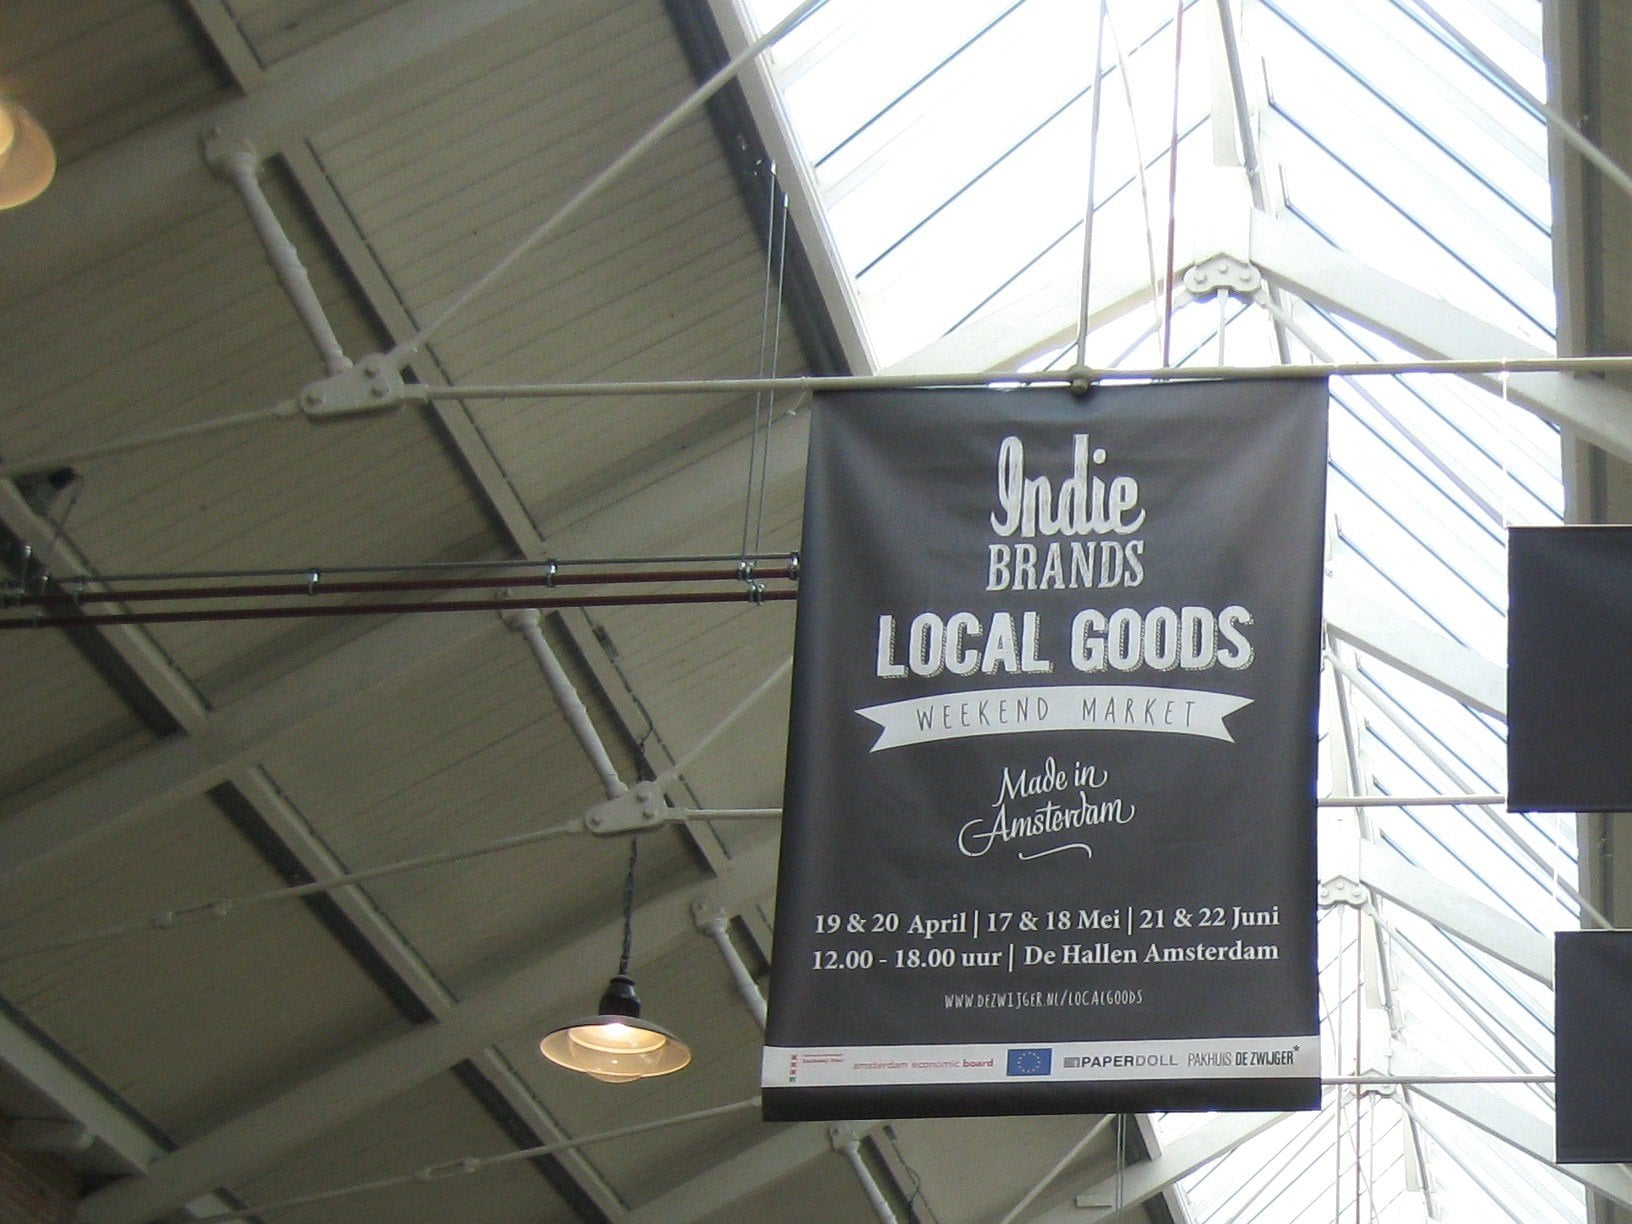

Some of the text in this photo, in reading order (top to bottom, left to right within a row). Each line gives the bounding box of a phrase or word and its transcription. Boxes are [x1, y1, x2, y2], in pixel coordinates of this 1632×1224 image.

[990, 433, 1146, 538] Indie
[985, 539, 1144, 591] BRANDS
[876, 605, 1254, 678] LOCAL GOODS
[916, 696, 1195, 732] WEEKEND MARKET
[991, 756, 1108, 807] Made in
[958, 790, 1135, 857] Amsterdam
[815, 914, 841, 934] 19
[846, 913, 867, 933] &
[871, 912, 899, 933] 20
[907, 912, 966, 940] April
[988, 912, 1013, 932] 17
[1018, 911, 1039, 931] &
[1046, 910, 1071, 931] 18
[1077, 909, 1121, 930] Mei
[1139, 909, 1164, 929] 21
[1173, 908, 1193, 928] &
[1198, 907, 1226, 927] 22
[1231, 905, 1280, 931] Juni
[812, 949, 874, 970] 12.00
[895, 948, 956, 968] 18.00
[961, 951, 1003, 967] uur
[1024, 945, 1056, 965] De
[1062, 942, 1138, 964] Hallen
[1143, 939, 1279, 963] Amsterdam
[962, 1058, 994, 1068] board
[1081, 1054, 1179, 1069] PAPERDOLL
[1234, 1051, 1249, 1066] DE
